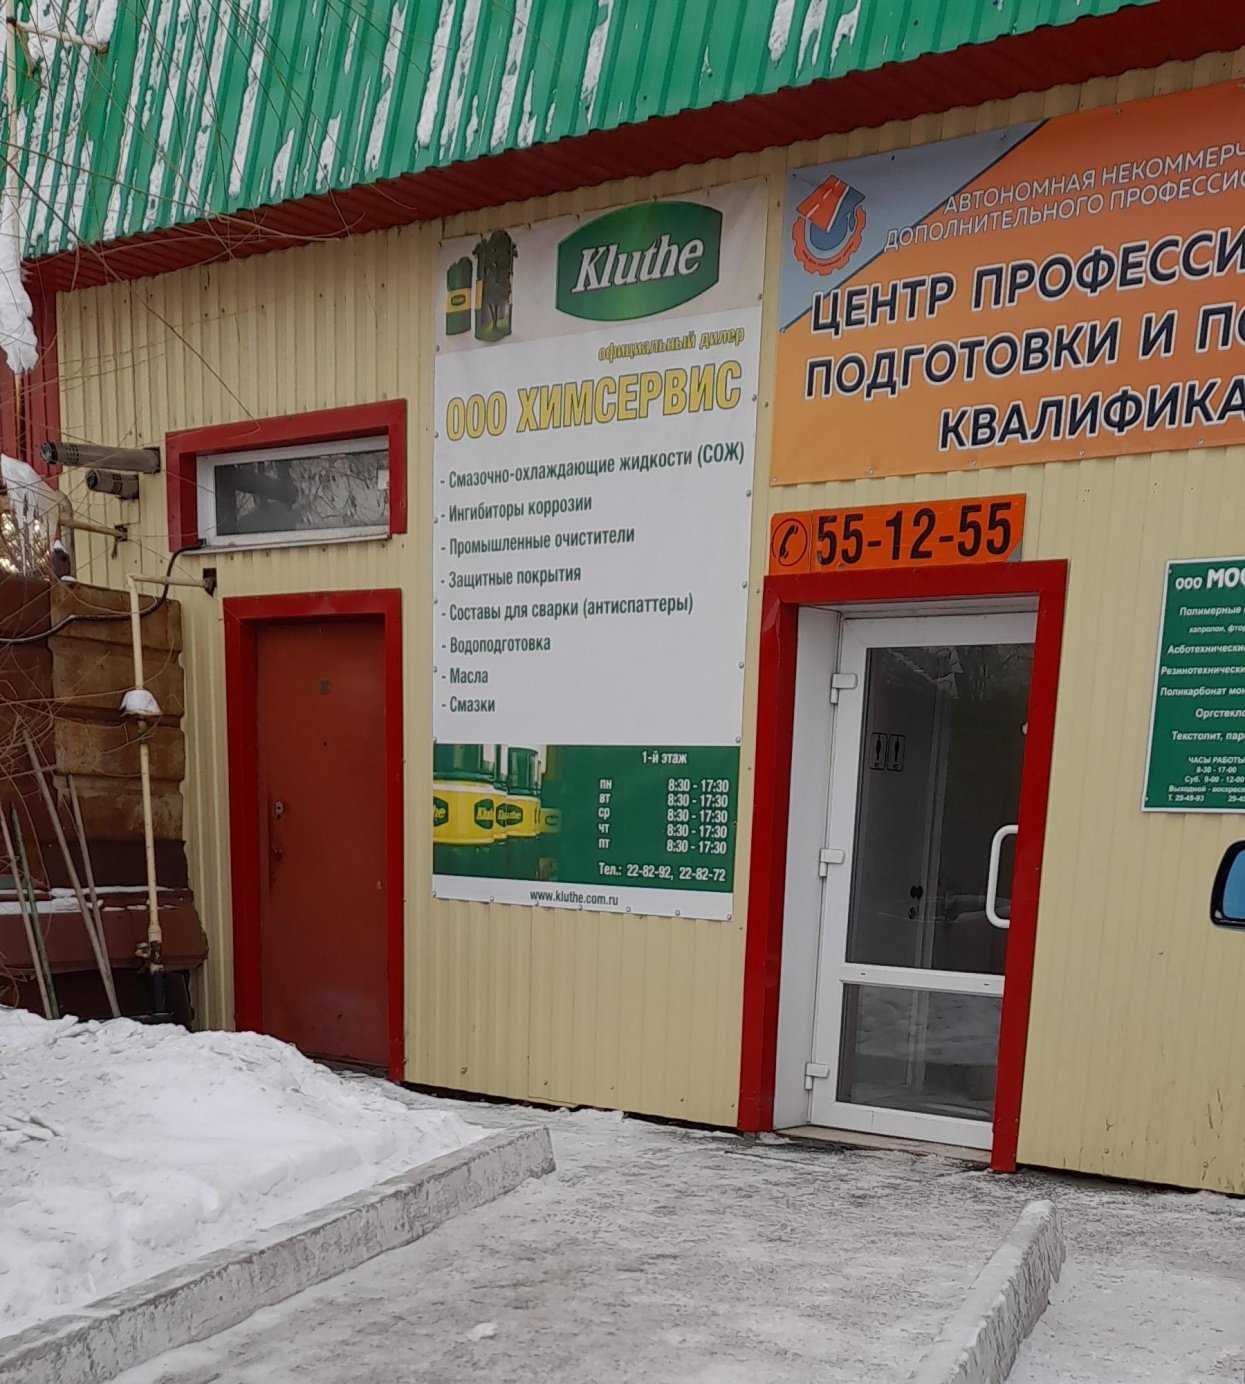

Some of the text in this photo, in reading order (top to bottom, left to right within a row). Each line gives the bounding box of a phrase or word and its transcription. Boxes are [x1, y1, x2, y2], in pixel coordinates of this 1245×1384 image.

[944, 168, 1096, 214] АВТОНОМНАЯ
[884, 194, 1104, 252] ДОПОЛНИТЕЛЬНОГО
[571, 234, 704, 294] Kluthe
[811, 226, 1245, 338] ЦЕНТР ПРОФЕССИ
[598, 327, 745, 363] официальный дилер
[805, 301, 1245, 400] ПОДГОТОВКИ И П
[447, 360, 742, 441] ООО ХИМСЕРВИС
[449, 459, 615, 488] Смазочно-охлаждающие
[619, 449, 693, 473] жидкости
[697, 441, 744, 468] (СОЖ)
[449, 501, 524, 522] Ингибиторы
[528, 497, 592, 517] коррозии
[449, 533, 550, 557] Промышленные
[554, 528, 635, 548] очистители
[817, 502, 1012, 566] 55-12-55
[449, 569, 512, 590] Защитные
[517, 566, 581, 586] покрытия
[1206, 567, 1245, 588] МО
[449, 603, 501, 621] Составы
[504, 603, 528, 621] для
[531, 600, 579, 619] сварки
[583, 593, 693, 618] (антиспаттеры)
[450, 636, 551, 655] Водоподготовка
[450, 667, 488, 684] Масла
[450, 696, 495, 712] Смазки
[661, 753, 687, 765] этаж
[668, 779, 690, 792] 8:30
[701, 779, 729, 792] 17:30
[667, 794, 689, 807] 8:30
[700, 794, 728, 807] 17:30
[667, 809, 689, 822] 8:30
[700, 810, 728, 823] 17:30
[667, 824, 688, 837] 8:30
[699, 825, 728, 838] 17:30
[666, 839, 688, 852] 8:30
[698, 841, 727, 854] 17:30
[599, 862, 726, 881] Тел.: 22-82-92, 22-82-72
[530, 889, 619, 906] www.kluthe.com.ru
